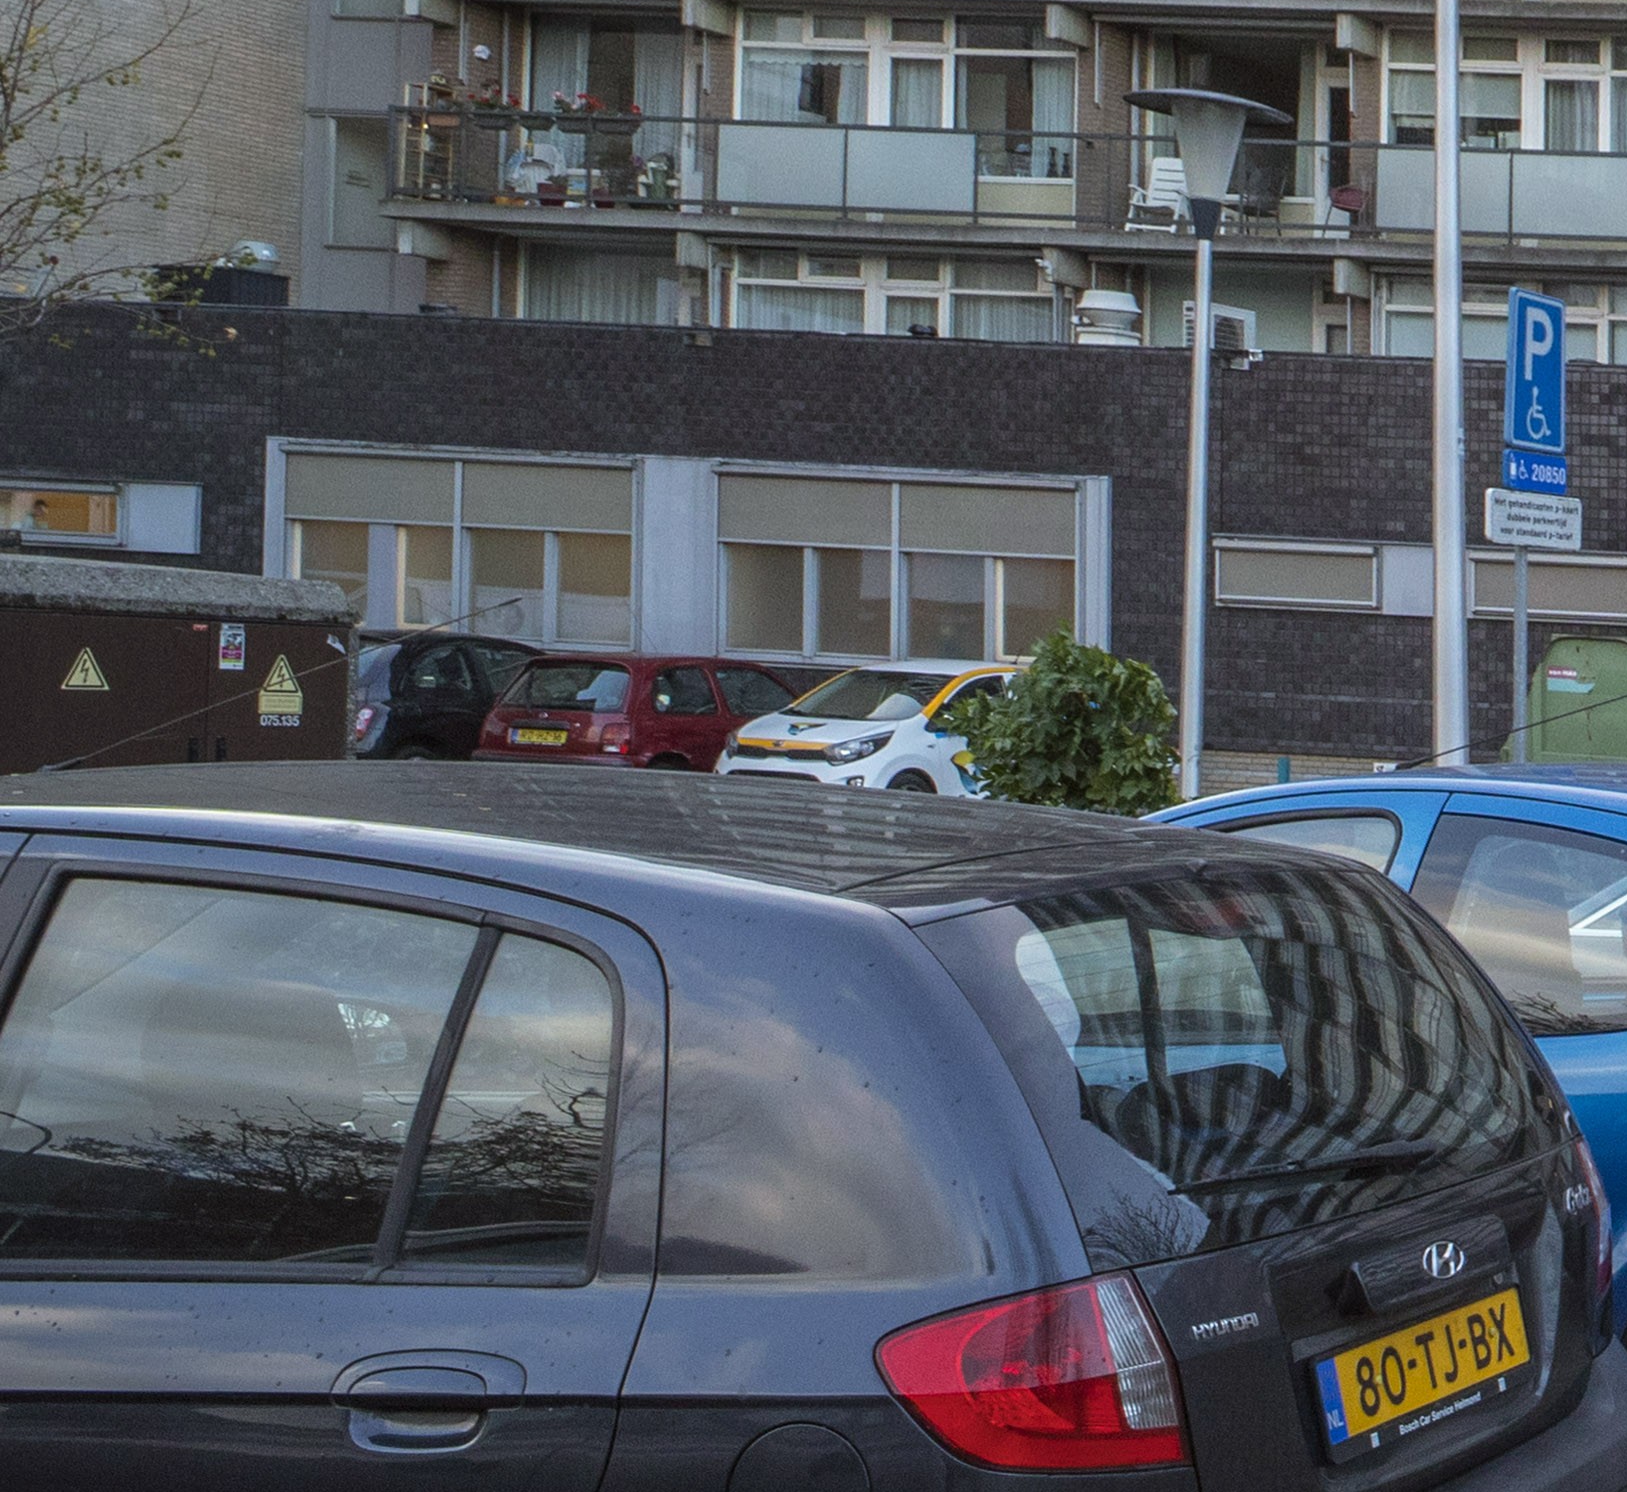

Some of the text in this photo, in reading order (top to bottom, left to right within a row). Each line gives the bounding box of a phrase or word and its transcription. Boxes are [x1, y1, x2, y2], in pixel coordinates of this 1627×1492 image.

[1524, 306, 1554, 381] P
[1531, 463, 1566, 486] 20850
[260, 715, 300, 727] 075.135
[1191, 1312, 1259, 1341] HYUNDAI
[1327, 1302, 1516, 1430] NL 80-TJ-BX
[1419, 1415, 1431, 1427] Car
